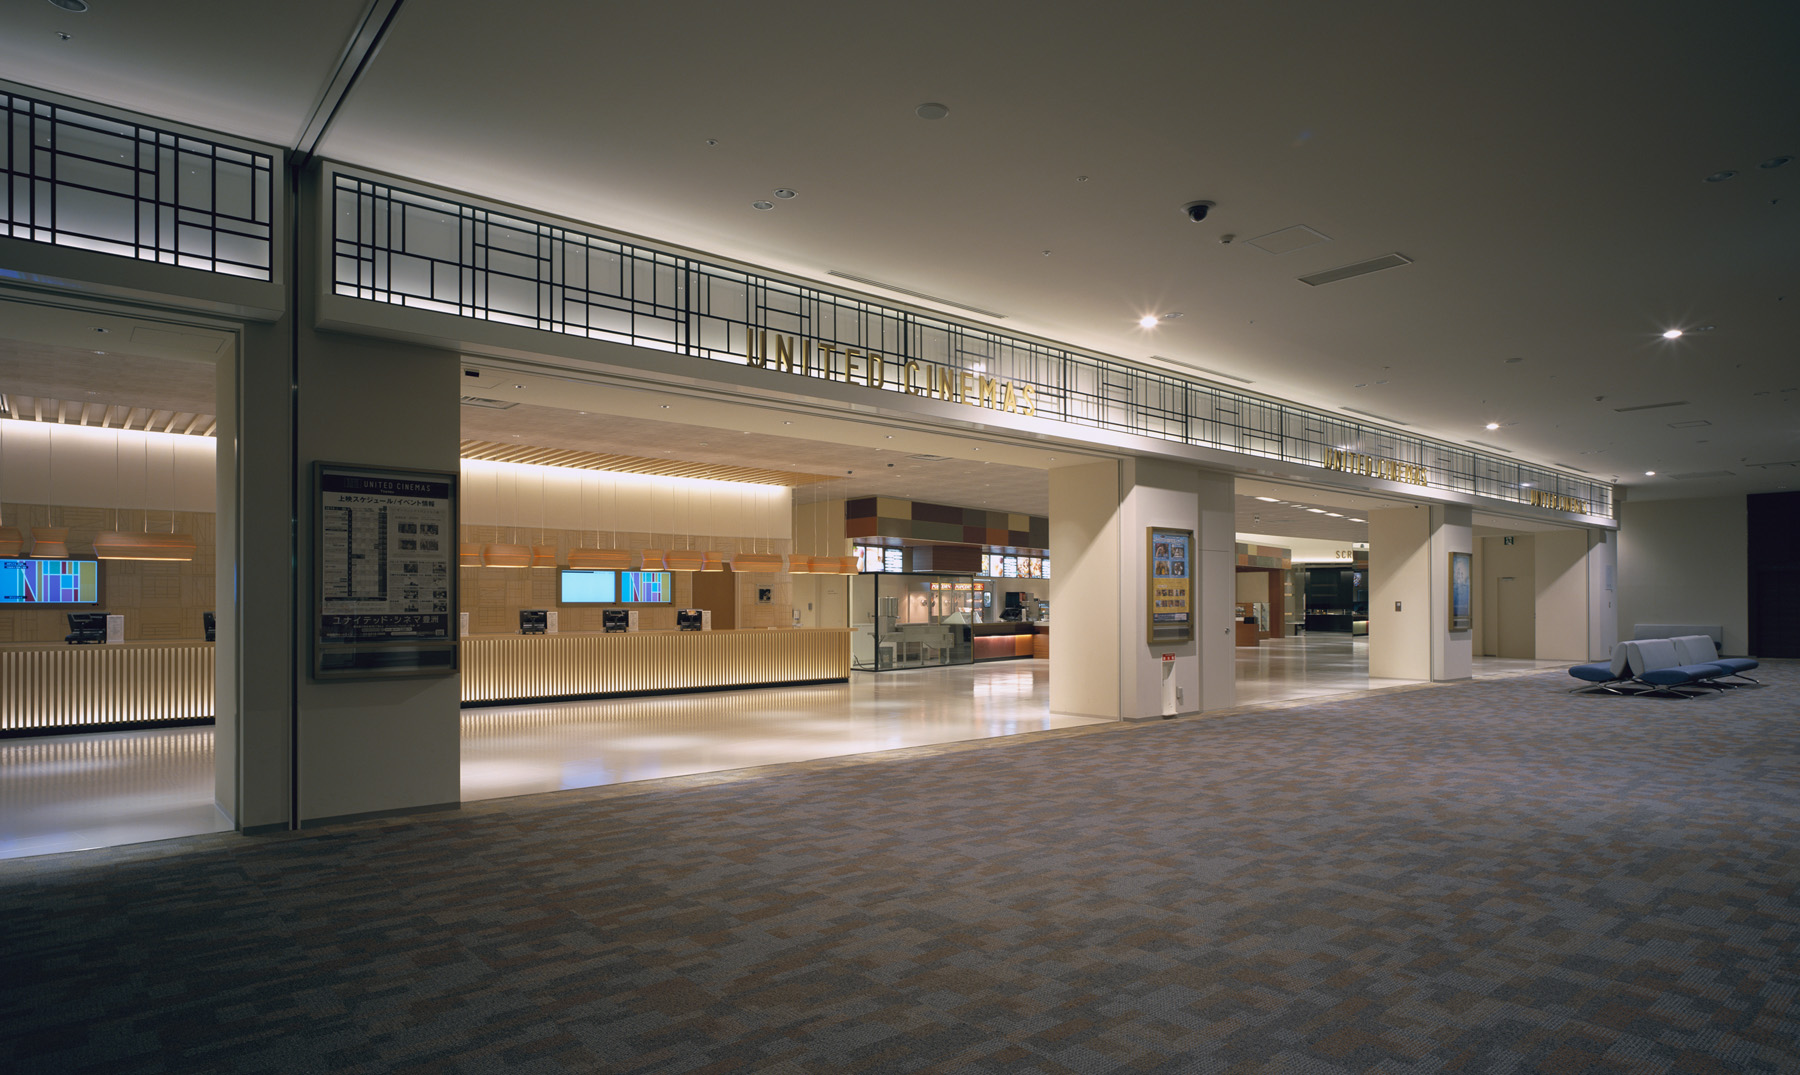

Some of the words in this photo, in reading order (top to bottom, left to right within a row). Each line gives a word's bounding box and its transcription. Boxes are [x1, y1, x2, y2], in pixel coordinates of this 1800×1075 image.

[746, 327, 885, 390] UNITED
[904, 360, 1036, 417] CINEMAS
[1324, 446, 1373, 478] UNITED
[1377, 459, 1428, 487] CINEMAS
[363, 480, 394, 490] UNITED
[396, 482, 431, 492] CINEMAS
[338, 495, 436, 507] 上映スケジュール/イベント情報
[332, 615, 439, 625] ユナイテッド・シネマ豊洲
